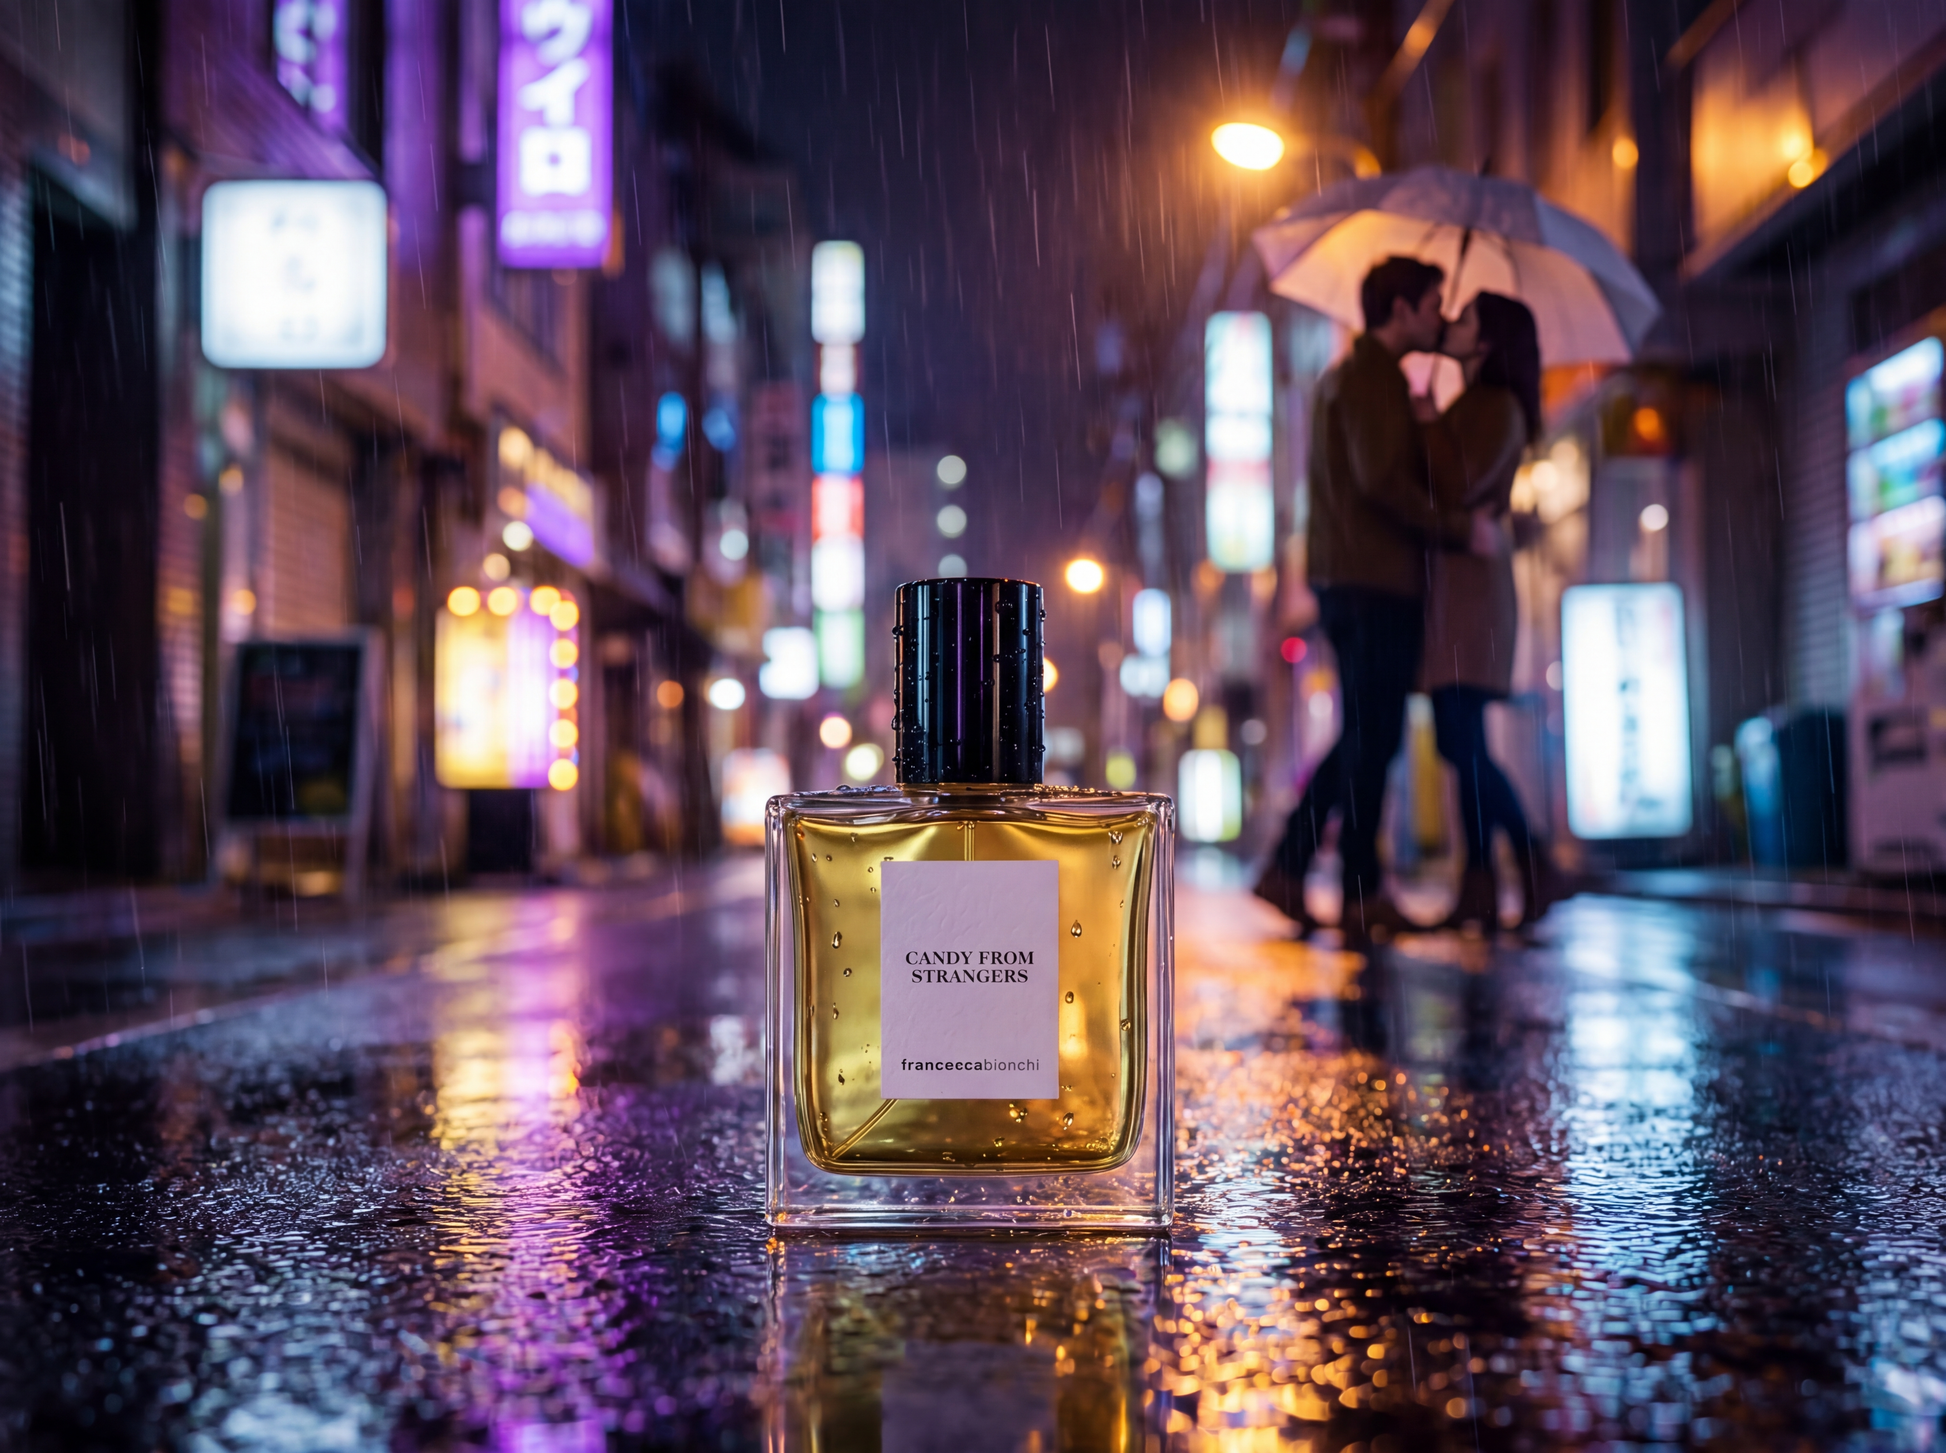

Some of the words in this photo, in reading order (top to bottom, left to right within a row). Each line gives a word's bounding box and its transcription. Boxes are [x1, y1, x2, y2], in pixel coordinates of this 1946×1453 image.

[905, 950, 973, 966] CANDY
[978, 950, 1034, 966] FROM
[911, 969, 1029, 984] STRANGERS
